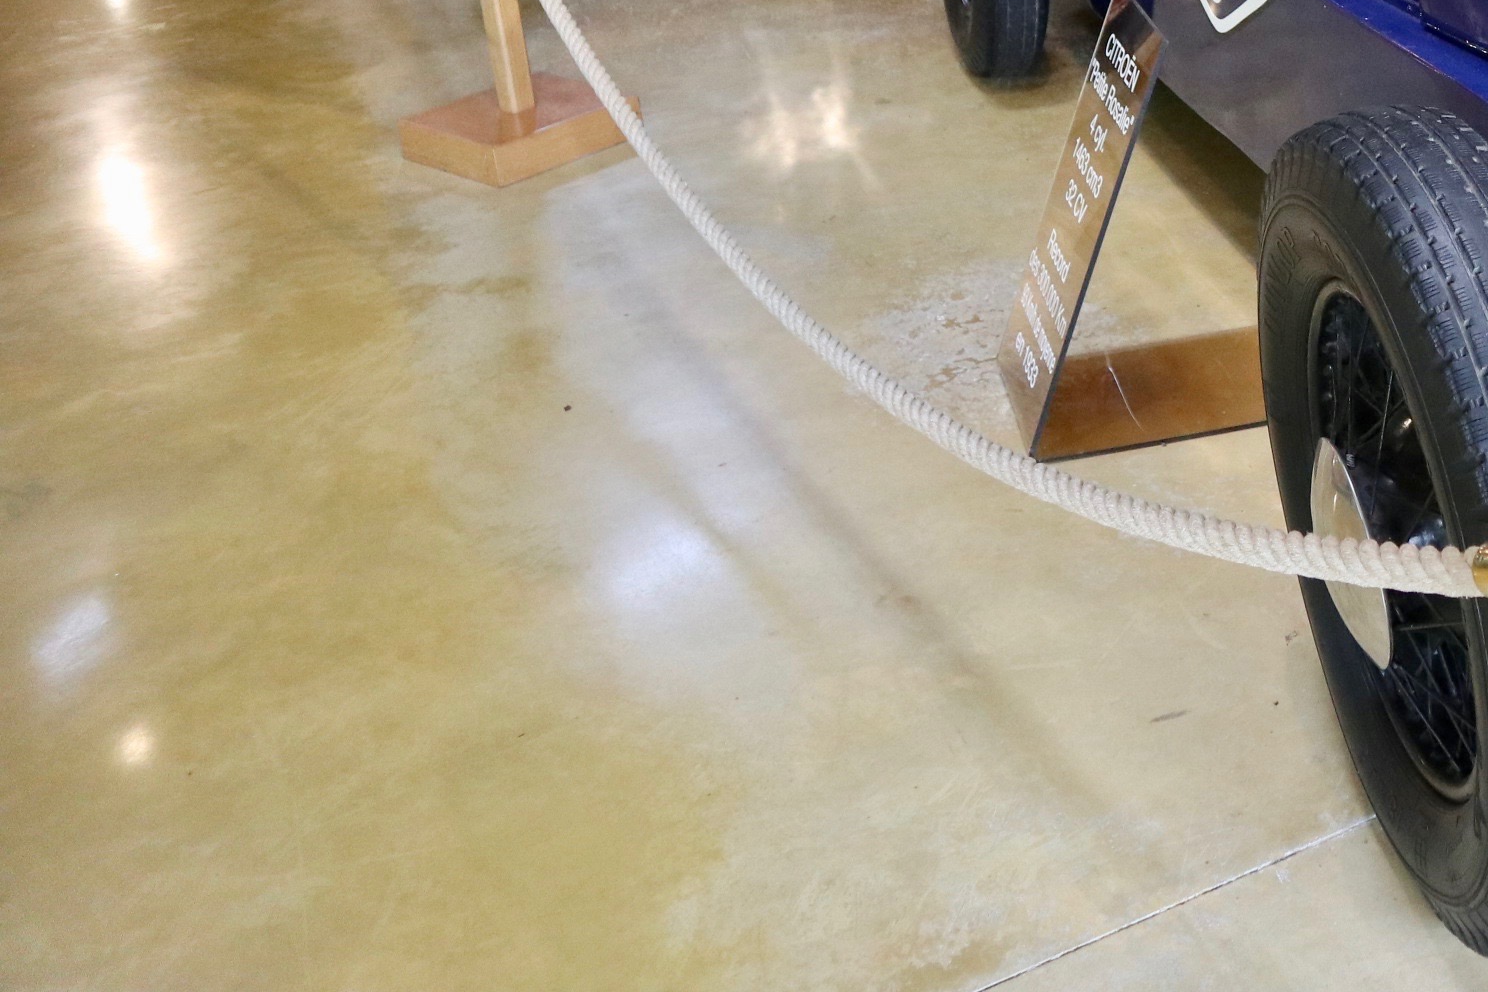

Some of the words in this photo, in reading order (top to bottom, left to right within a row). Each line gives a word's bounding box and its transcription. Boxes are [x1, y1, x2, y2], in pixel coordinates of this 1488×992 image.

[1105, 33, 1140, 93] CITROËN
[1089, 114, 1098, 133] 4
[1090, 57, 1108, 102] "Petite
[1105, 84, 1136, 135] Rosalie"
[1073, 136, 1090, 176] 1463
[1086, 165, 1104, 199] cm3
[1065, 178, 1078, 208] 32
[1073, 191, 1088, 224] CV
[1047, 228, 1071, 283] Record
[1029, 246, 1041, 277] des
[1055, 306, 1067, 339] Km
[1016, 332, 1025, 356] en
[1023, 345, 1039, 389] 1933
